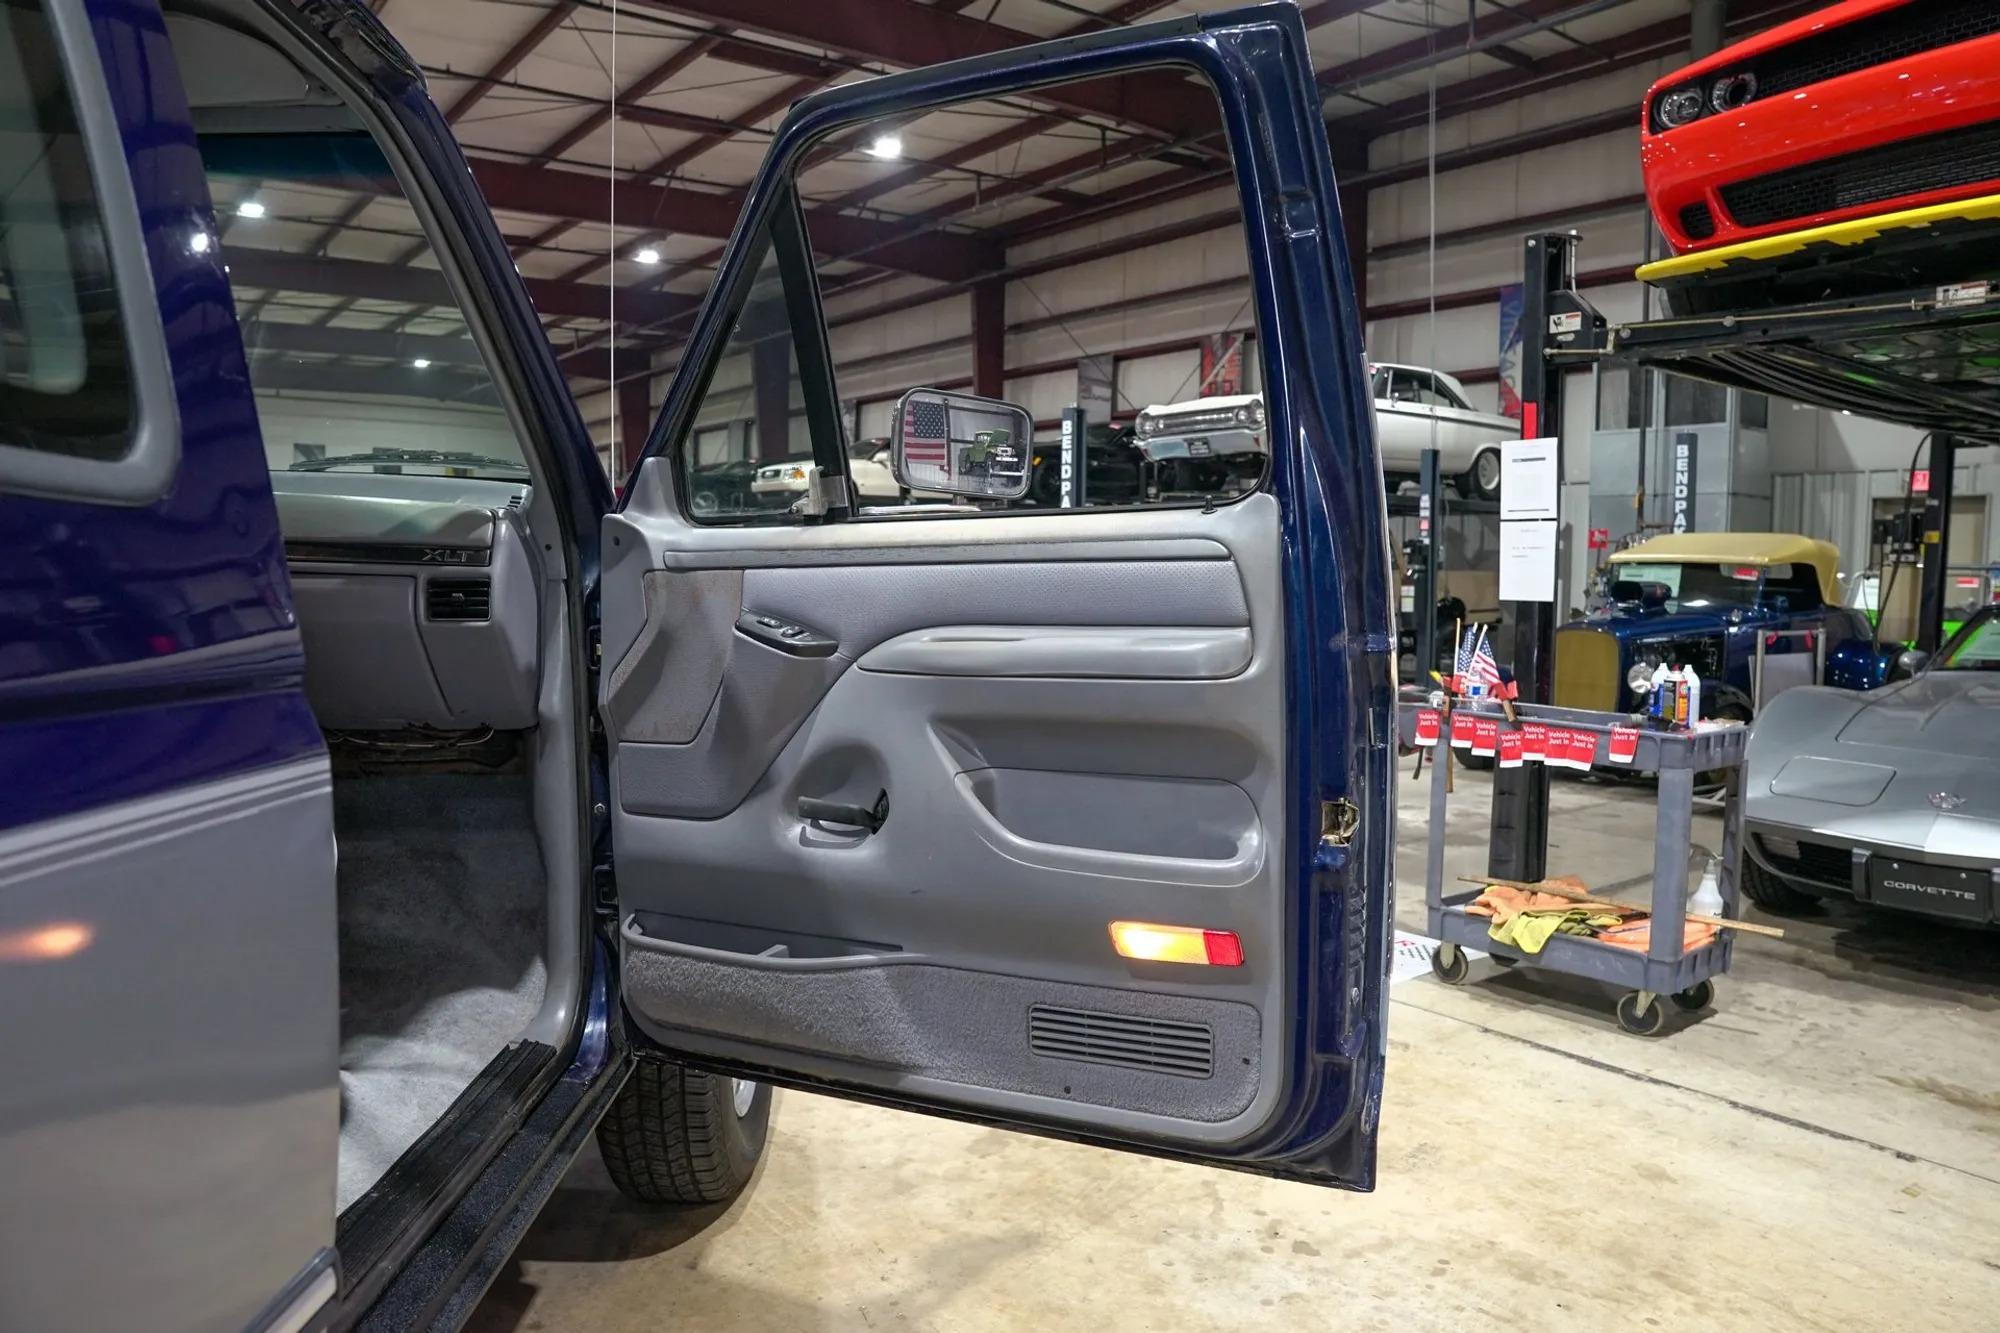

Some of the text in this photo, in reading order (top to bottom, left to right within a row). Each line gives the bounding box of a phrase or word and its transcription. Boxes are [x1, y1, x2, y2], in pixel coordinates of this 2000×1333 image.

[422, 549, 474, 562] XLT
[1572, 733, 1596, 742] Vehicle
[1572, 740, 1586, 748] Just
[1883, 880, 1976, 900] CORVETTE
